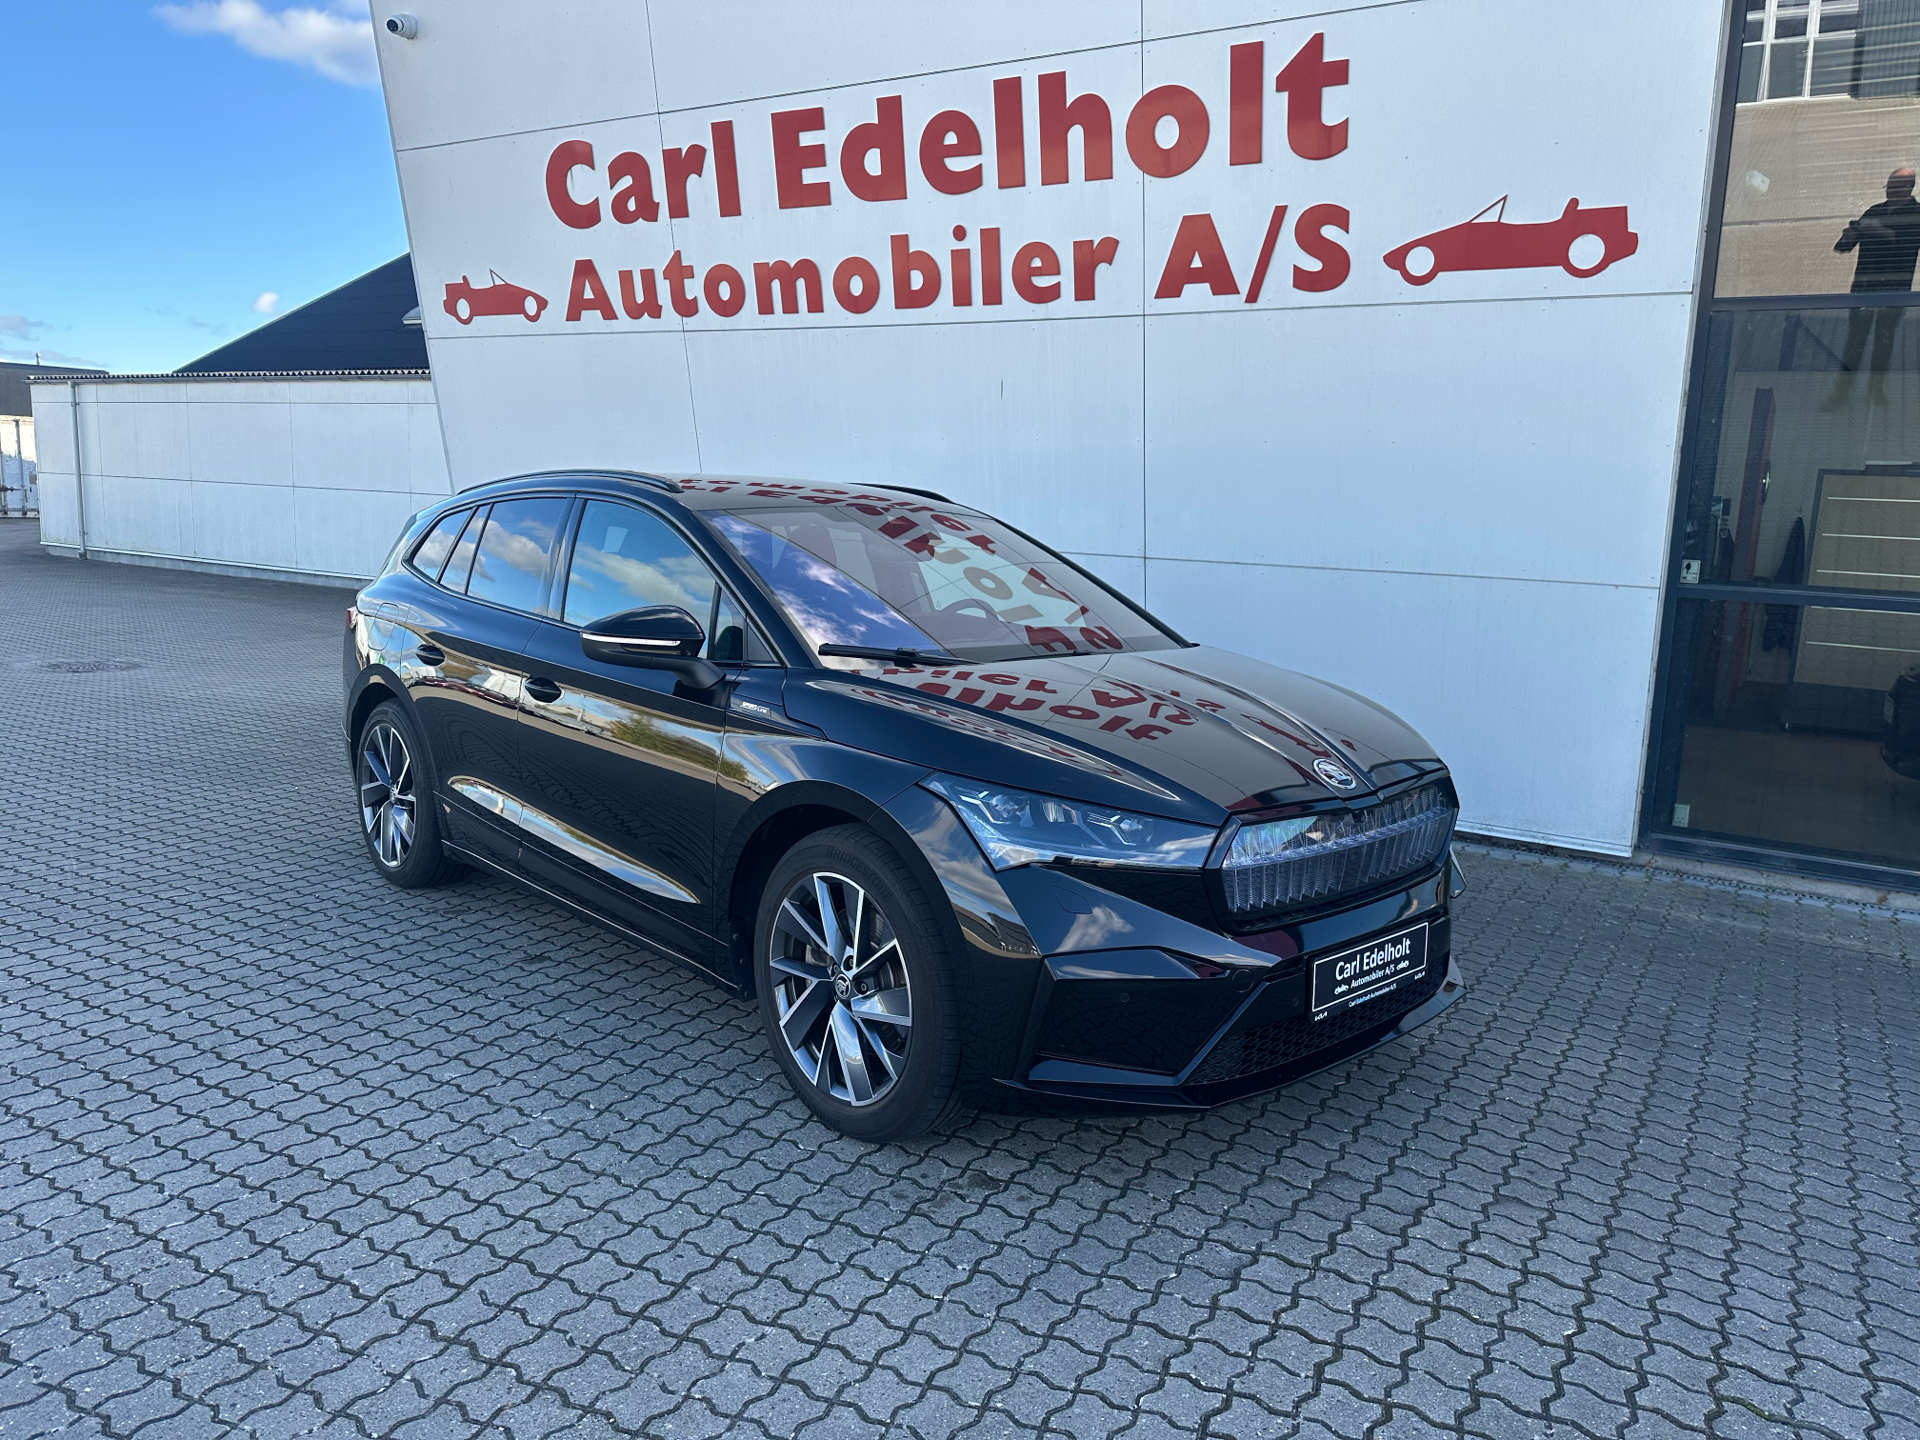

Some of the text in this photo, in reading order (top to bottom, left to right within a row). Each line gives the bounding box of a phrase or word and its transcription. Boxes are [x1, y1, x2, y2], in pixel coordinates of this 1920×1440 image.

[545, 31, 1350, 230] Carl Edelholt
[564, 202, 1351, 323] Automobiler A/S
[1335, 937, 1410, 980] Carl Edelholt
[1351, 964, 1395, 988] Automobiler A/S
